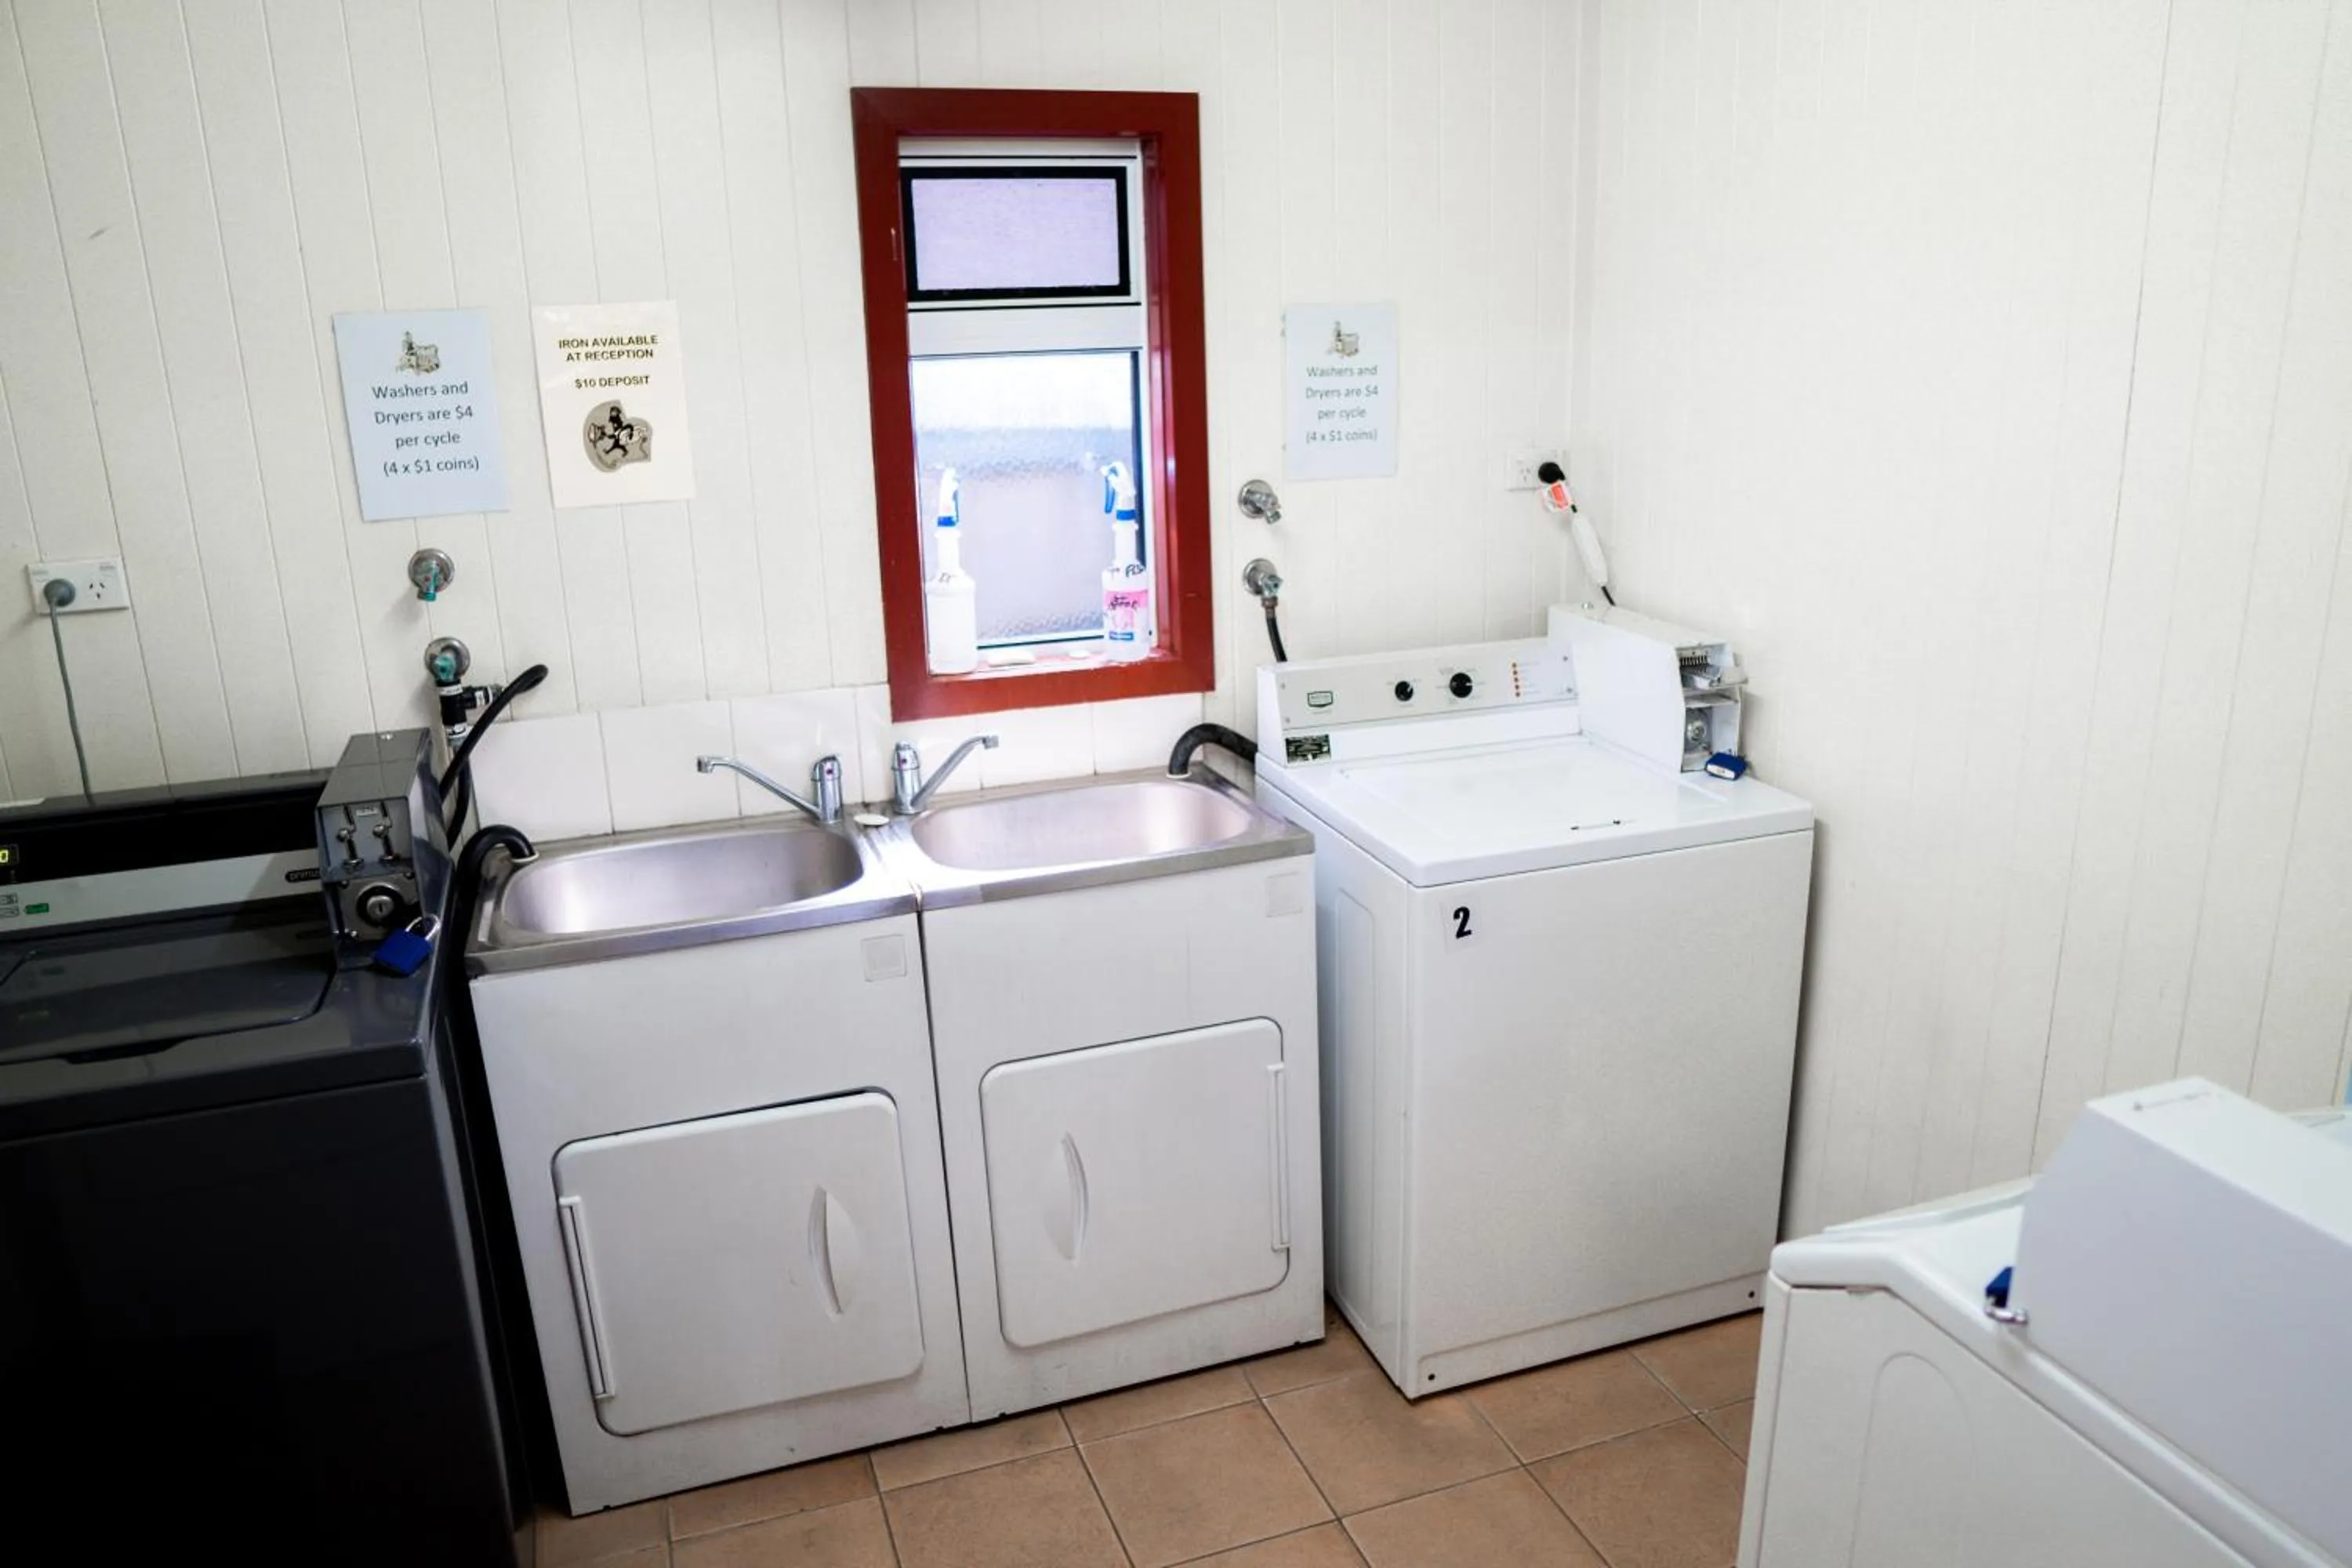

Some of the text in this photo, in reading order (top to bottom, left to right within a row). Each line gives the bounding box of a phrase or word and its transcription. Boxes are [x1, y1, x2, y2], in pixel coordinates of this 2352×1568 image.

[557, 335, 659, 349] IRON AVAILABLE
[566, 349, 654, 362] AT RECEPTION
[1306, 364, 1378, 377] Washers and
[372, 380, 469, 399] Washers and
[575, 376, 650, 390] $10 DEPOSIT
[1305, 386, 1342, 401] Dryers
[1344, 387, 1363, 397] are
[374, 405, 474, 426] Dryers are $4
[1317, 405, 1367, 423] per cycle
[394, 430, 462, 450] per cycle
[383, 455, 480, 478] (4 x $1 coins)
[1453, 906, 1472, 938] 2
